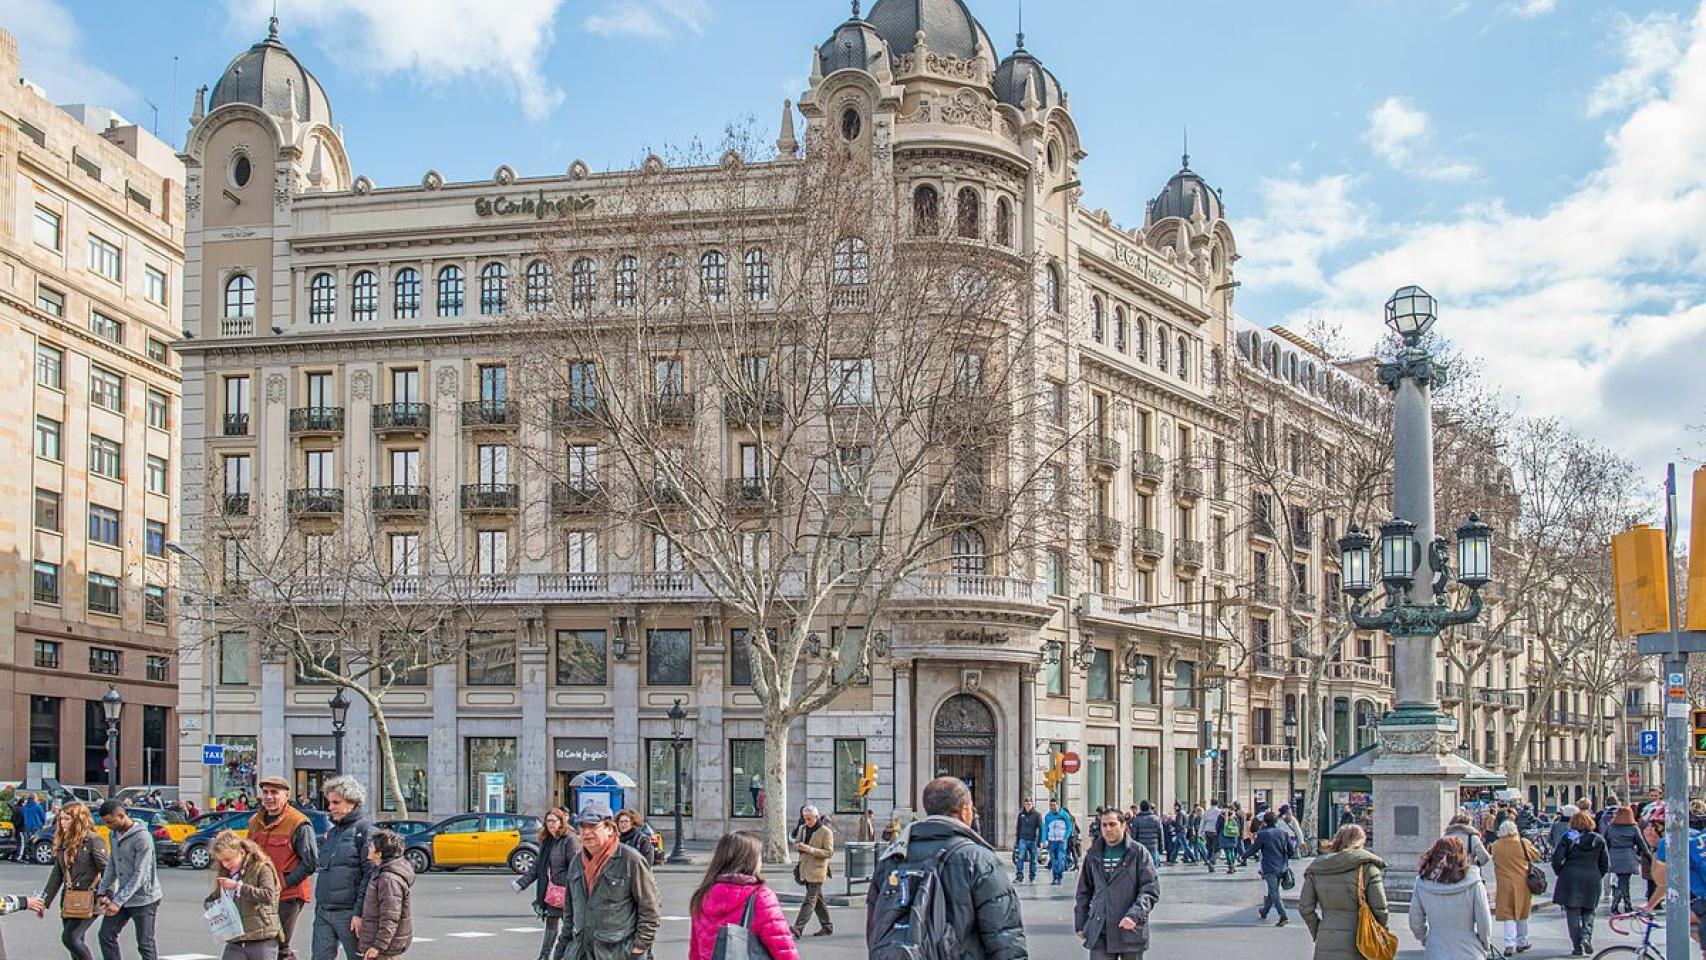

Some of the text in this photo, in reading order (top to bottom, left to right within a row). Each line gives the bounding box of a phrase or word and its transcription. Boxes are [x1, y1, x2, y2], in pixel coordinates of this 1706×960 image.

[475, 196, 492, 217] El
[494, 196, 534, 215] Corte
[1645, 734, 1653, 744] P
[205, 751, 224, 759] TAXI
[295, 746, 302, 756] El
[302, 747, 319, 756] Corte
[556, 747, 608, 761] El Corte Inglés
